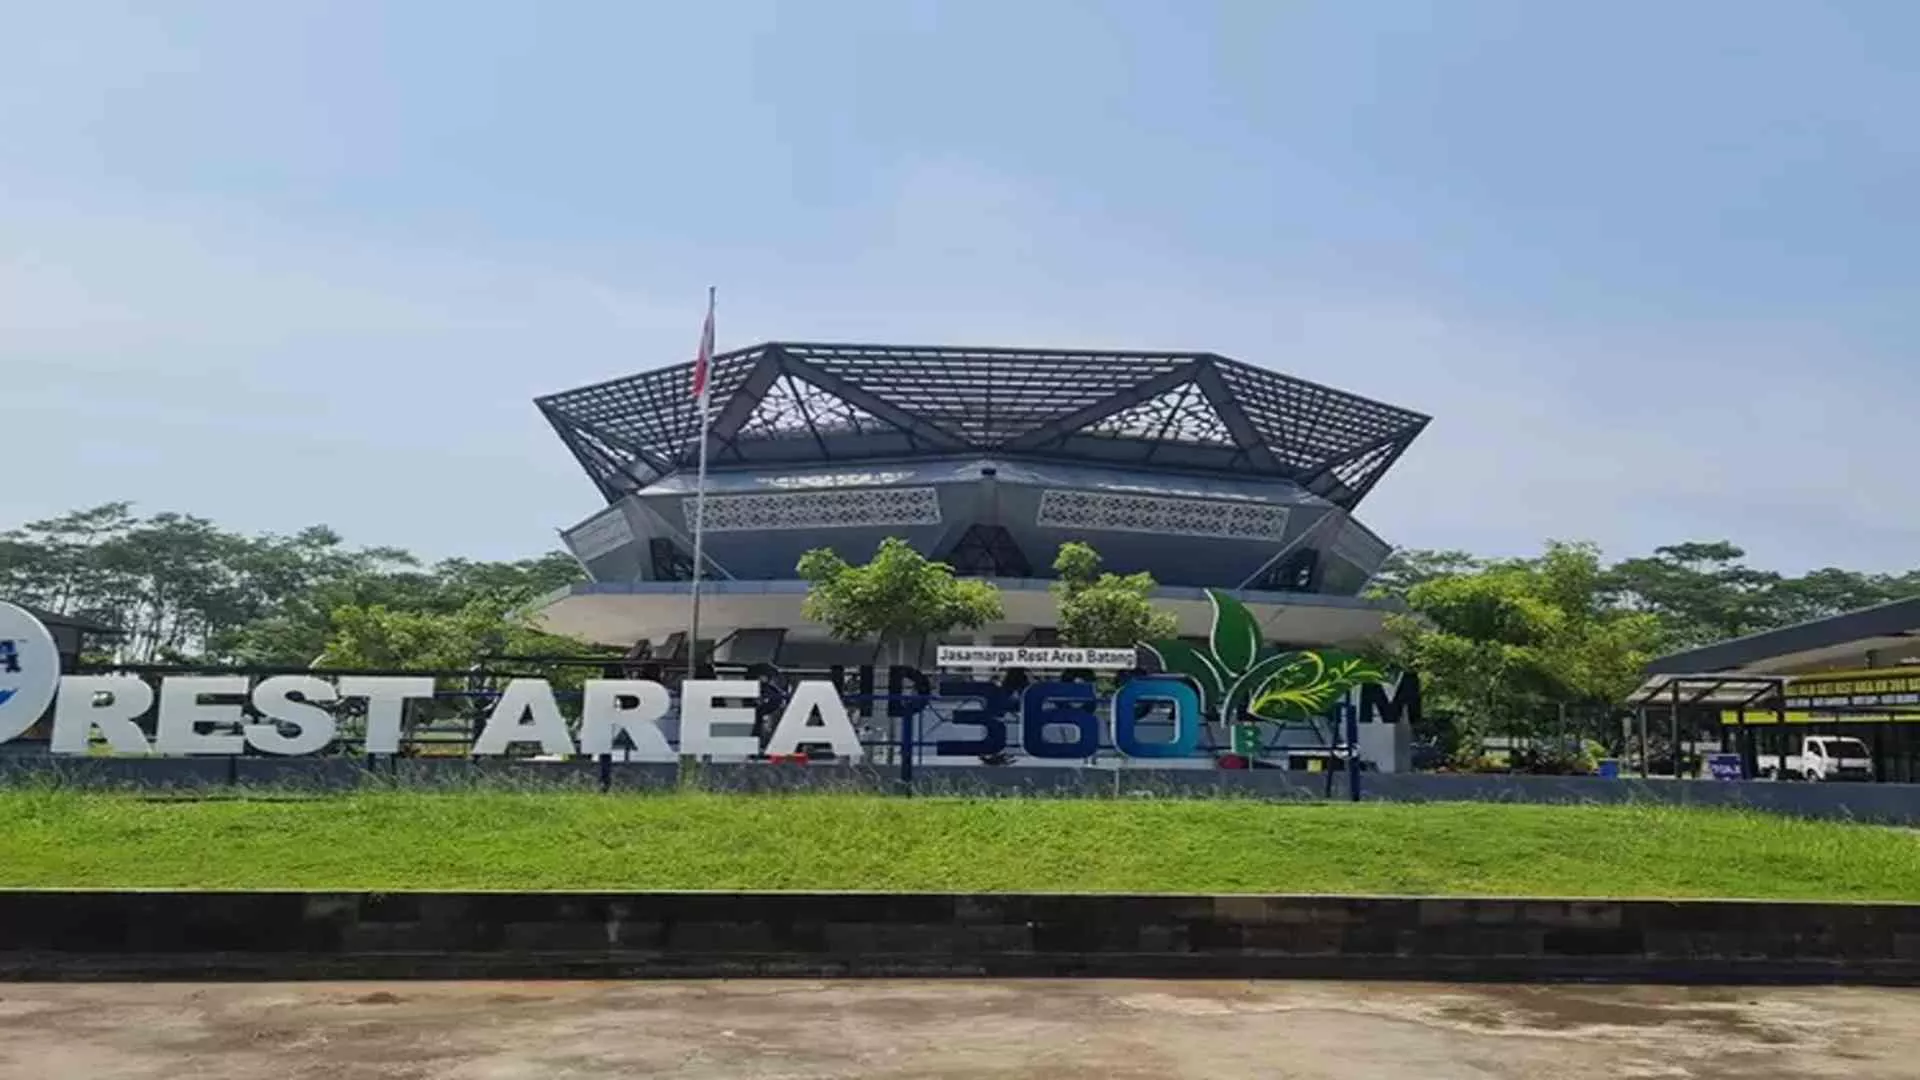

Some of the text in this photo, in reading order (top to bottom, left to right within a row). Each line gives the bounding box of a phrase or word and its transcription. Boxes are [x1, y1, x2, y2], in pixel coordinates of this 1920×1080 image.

[940, 648, 1135, 667] Jasamarga Rest Area Batang
[50, 674, 436, 755] REST
[471, 678, 865, 759] AREA
[936, 678, 1202, 759] 360
[1231, 723, 1263, 755] B
